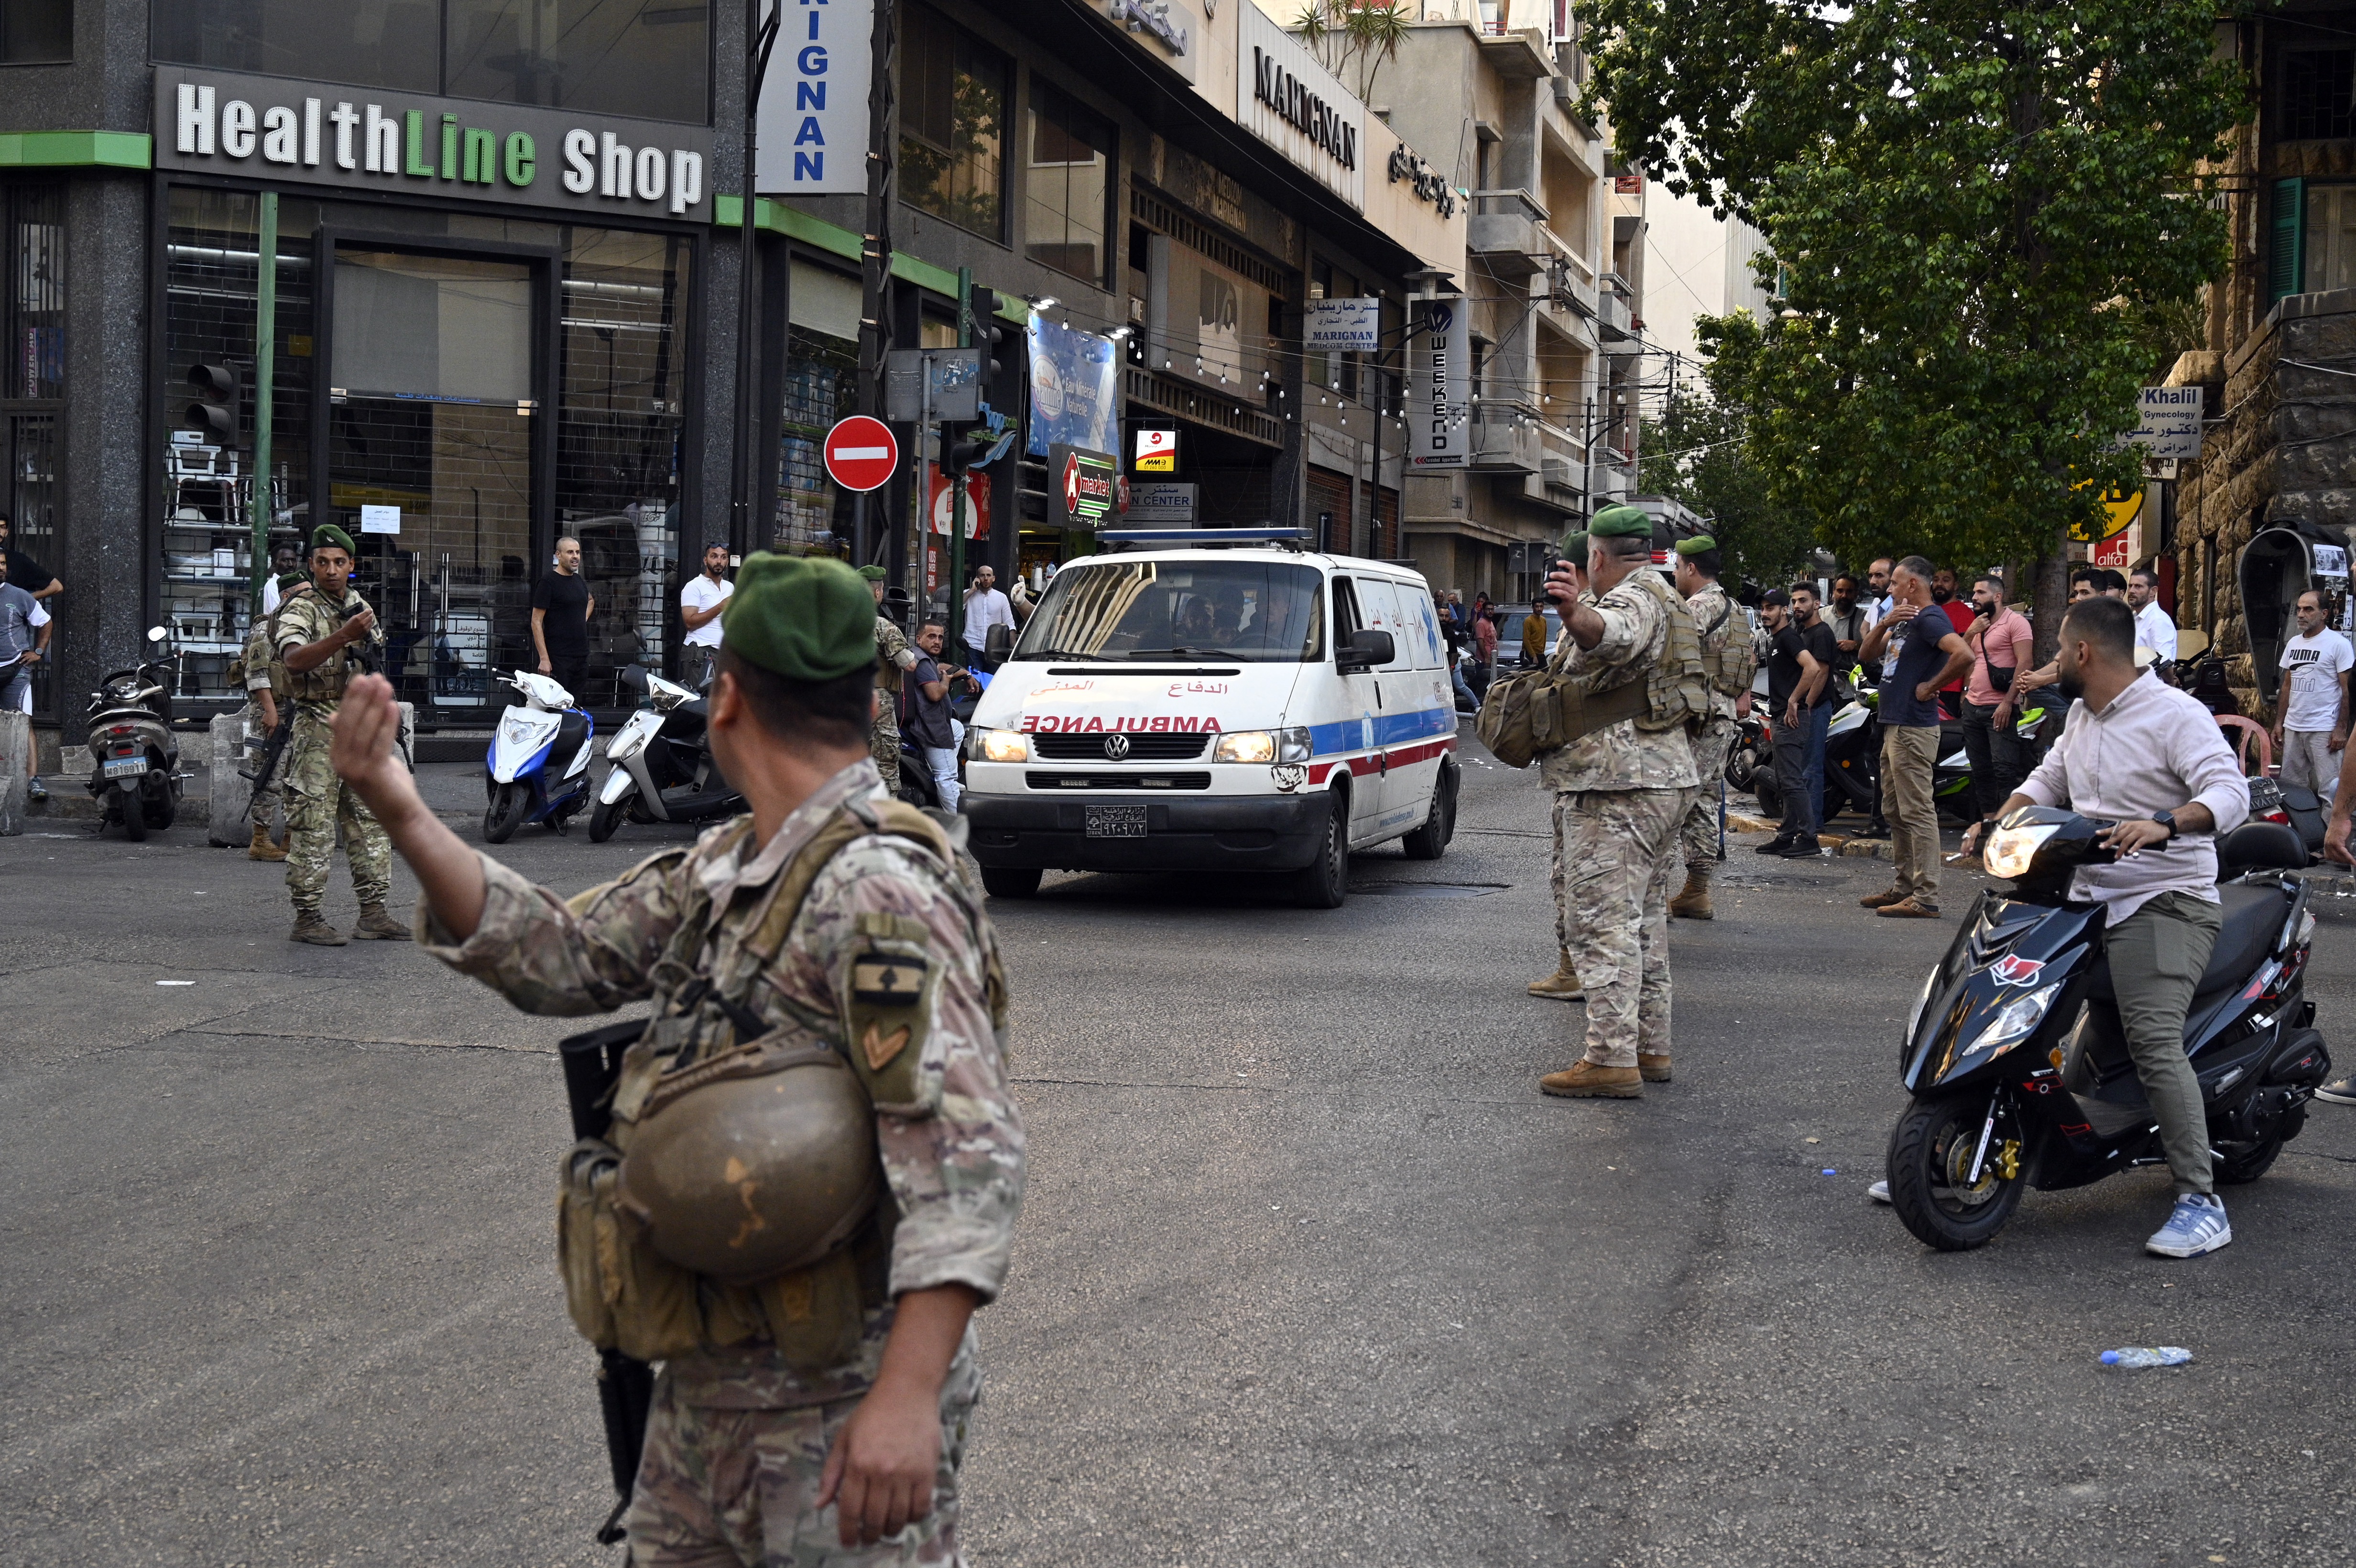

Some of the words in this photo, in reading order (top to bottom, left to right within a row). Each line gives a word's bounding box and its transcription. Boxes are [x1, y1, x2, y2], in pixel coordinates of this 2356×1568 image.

[1254, 46, 1356, 171] MARIGNAN
[563, 129, 703, 213] Shop
[1213, 193, 1246, 233] MARIGNAN
[1313, 331, 1373, 340] MARIGNAN
[1037, 373, 1061, 409] Sannine
[1066, 377, 1074, 393] Eau
[1076, 380, 1096, 401] Minérale
[2145, 389, 2196, 404] Khalil
[1066, 398, 1087, 417] Naturelle
[2144, 411, 2195, 419] Gynecology
[1082, 474, 1110, 497] market
[1118, 484, 1129, 503] 24/7
[1147, 485, 1178, 495] سنتر
[1144, 496, 1189, 505] CENTER
[2098, 552, 2123, 566] alfa
[2289, 649, 2320, 662] PUMA
[1168, 681, 1228, 697] الدفاع
[106, 763, 145, 776] M816911
